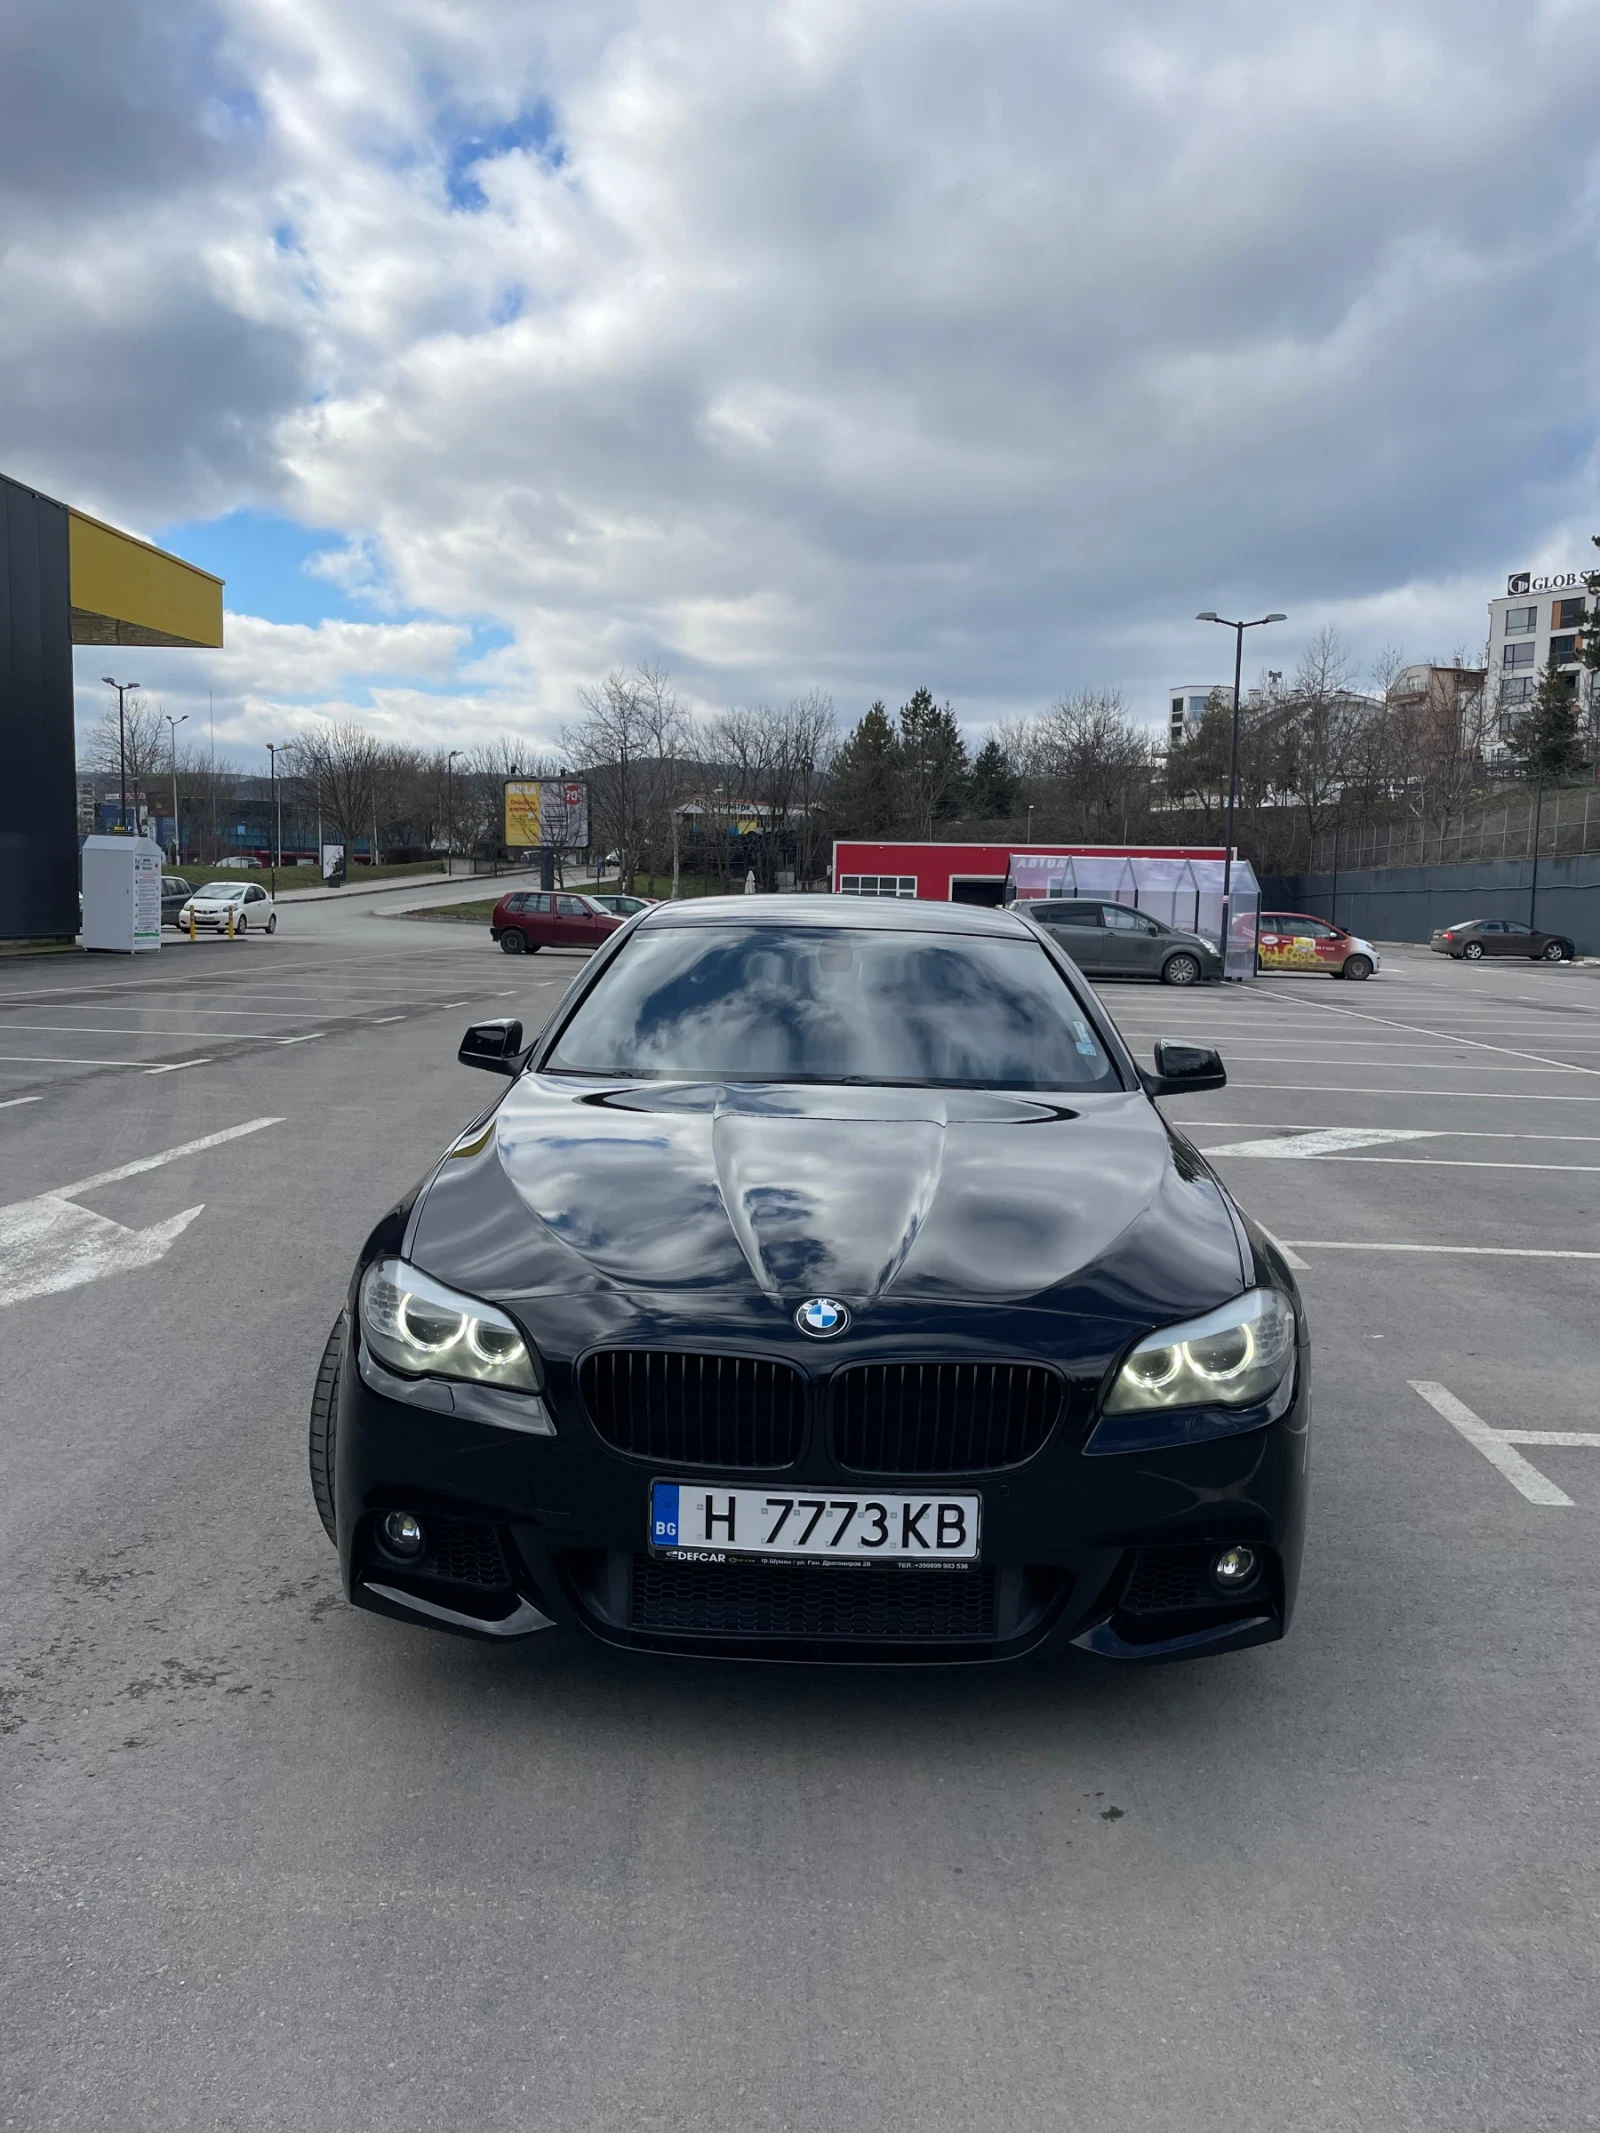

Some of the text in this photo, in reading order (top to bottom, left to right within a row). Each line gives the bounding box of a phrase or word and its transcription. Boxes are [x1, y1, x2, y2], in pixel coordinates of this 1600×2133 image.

[1531, 573, 1576, 590] GLOB
[705, 1495, 736, 1542] H
[655, 1521, 677, 1536] BG
[677, 1551, 726, 1563] DEFCAR
